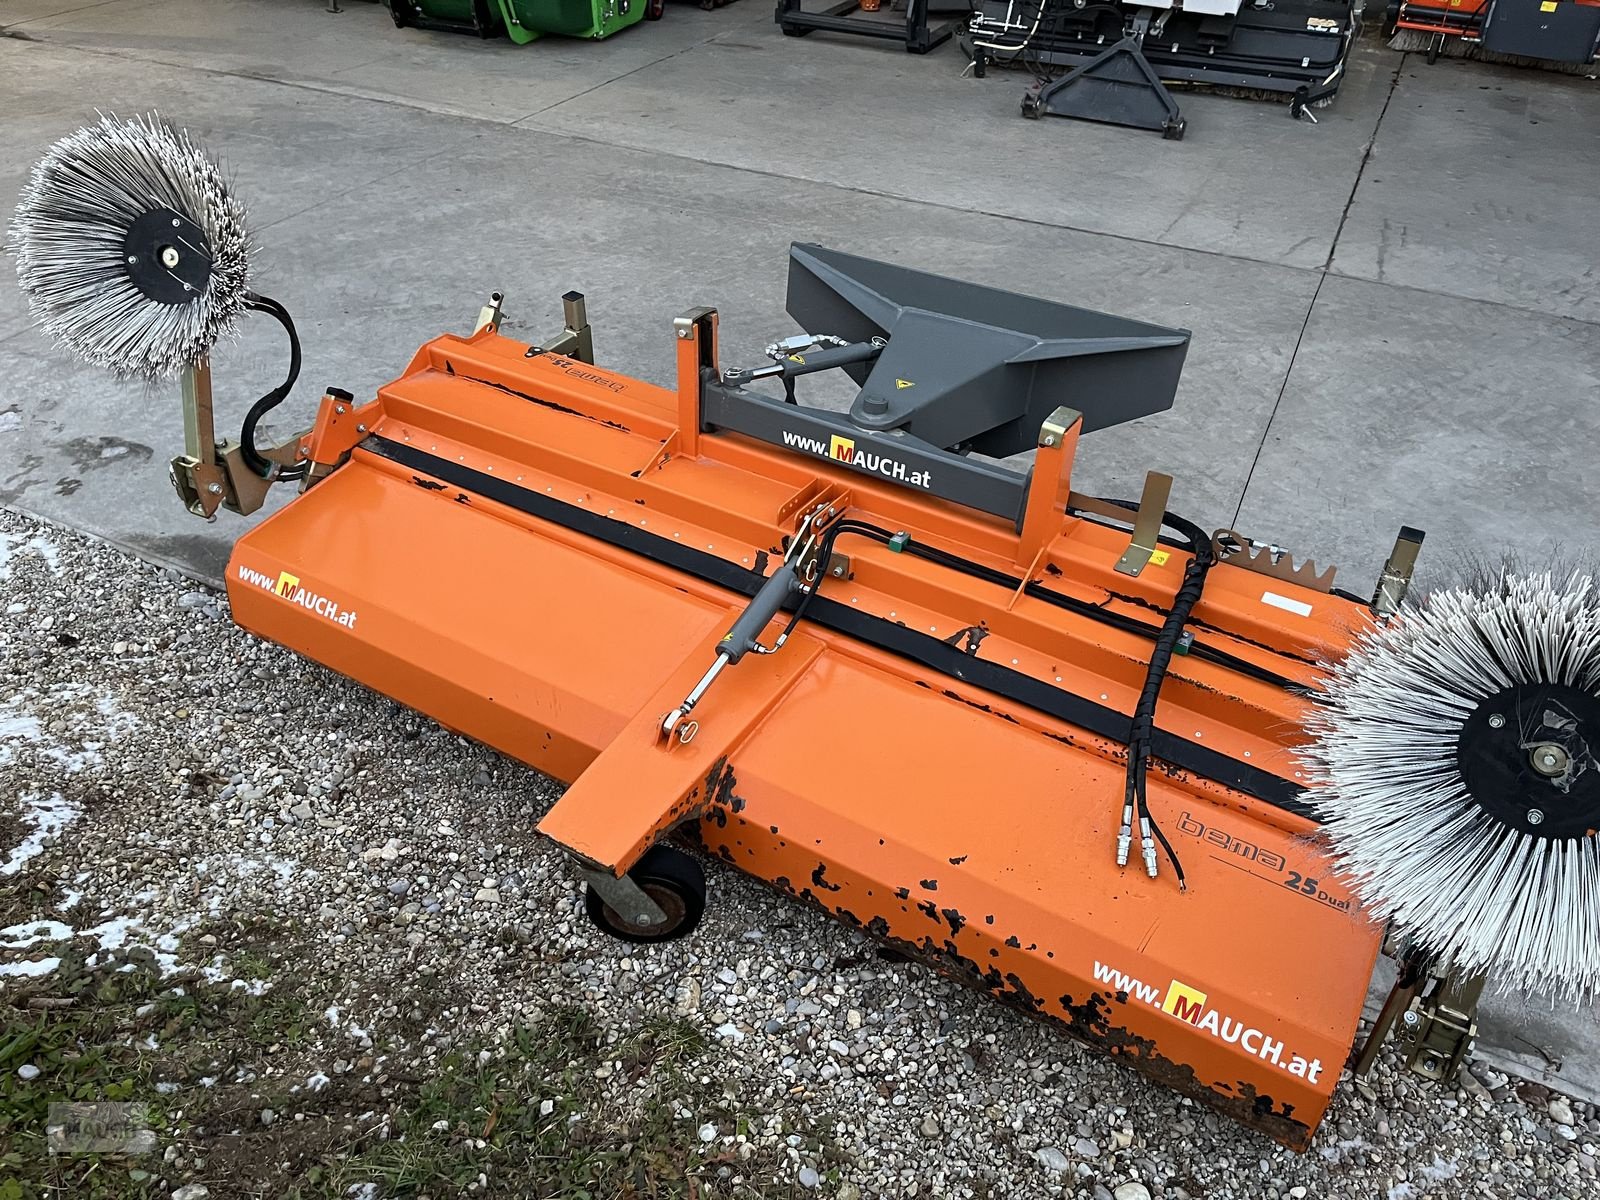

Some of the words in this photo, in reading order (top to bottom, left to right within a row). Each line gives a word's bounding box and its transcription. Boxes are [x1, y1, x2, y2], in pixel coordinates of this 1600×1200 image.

[552, 359, 573, 369] 25
[782, 430, 931, 488] www.MAUCH.at
[238, 565, 357, 629] www.MAUCH.at
[1176, 811, 1286, 872] bema
[1284, 870, 1319, 896] 25
[1317, 890, 1350, 910] Dual
[1093, 960, 1323, 1084] www.MAUCH.at
